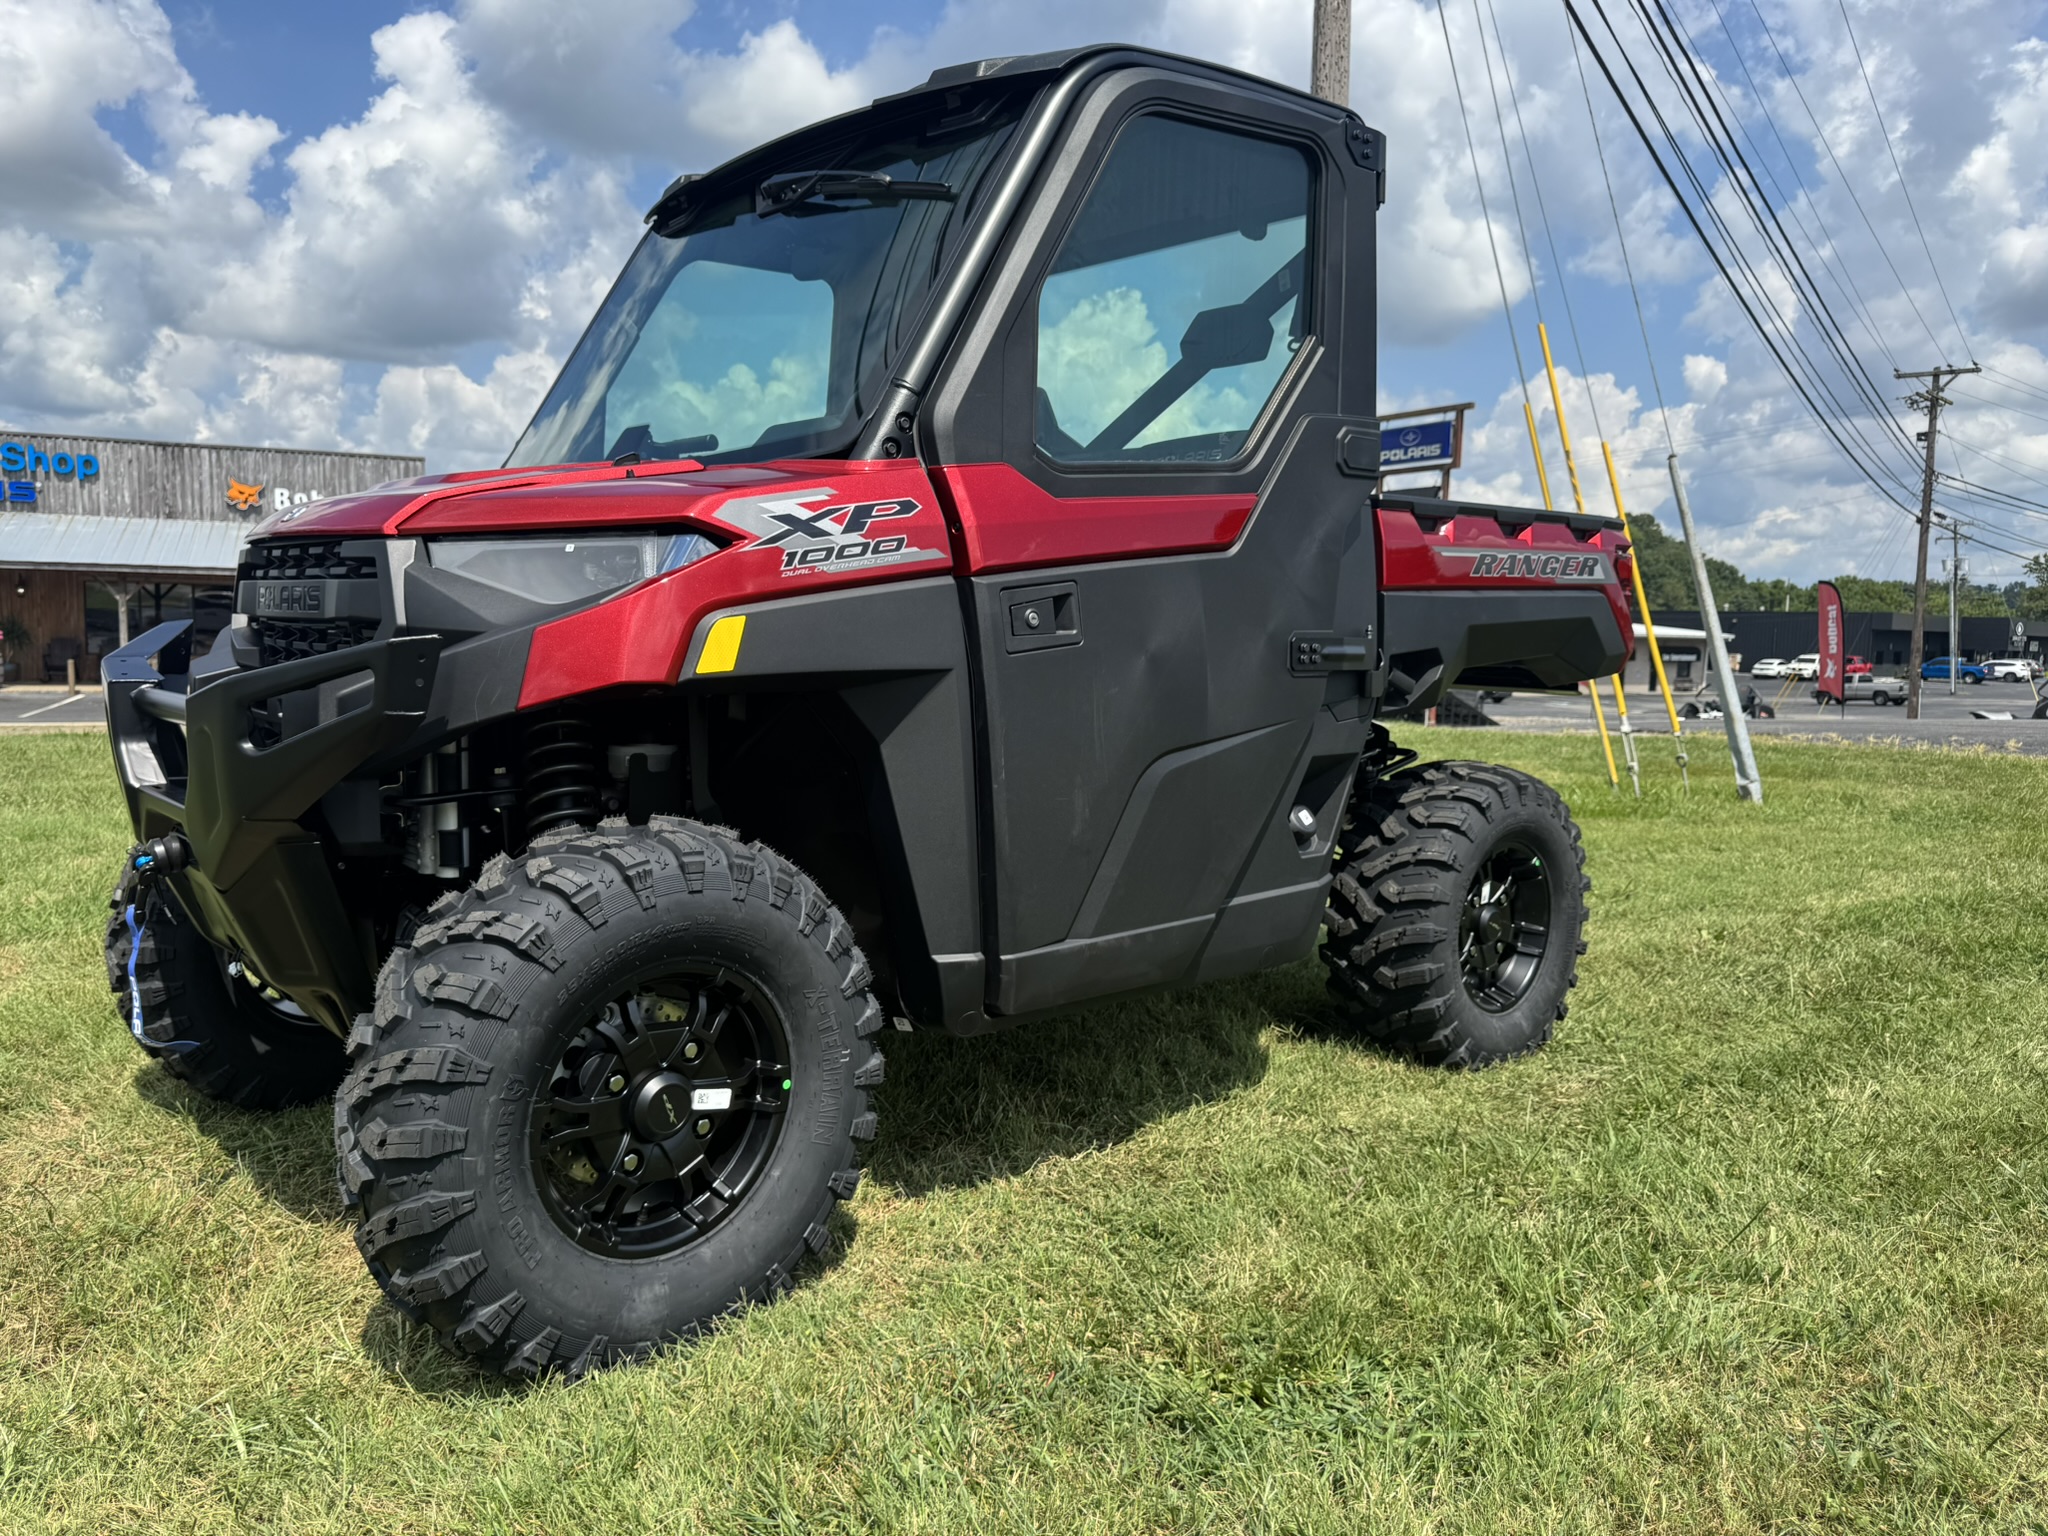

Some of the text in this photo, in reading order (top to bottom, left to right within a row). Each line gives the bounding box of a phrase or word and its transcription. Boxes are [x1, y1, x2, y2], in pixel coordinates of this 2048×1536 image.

[0, 442, 100, 480] Shop
[1379, 442, 1442, 463] POLARIS
[737, 498, 923, 551] XP
[780, 535, 907, 571] 1000
[781, 554, 902, 578] DUAL OVERHEAD CAM
[1469, 552, 1600, 577] RANGER
[257, 585, 321, 611] POLARIS
[803, 983, 844, 1147] X-TERRAIN
[494, 1105, 543, 1270] PRO ARMOR
